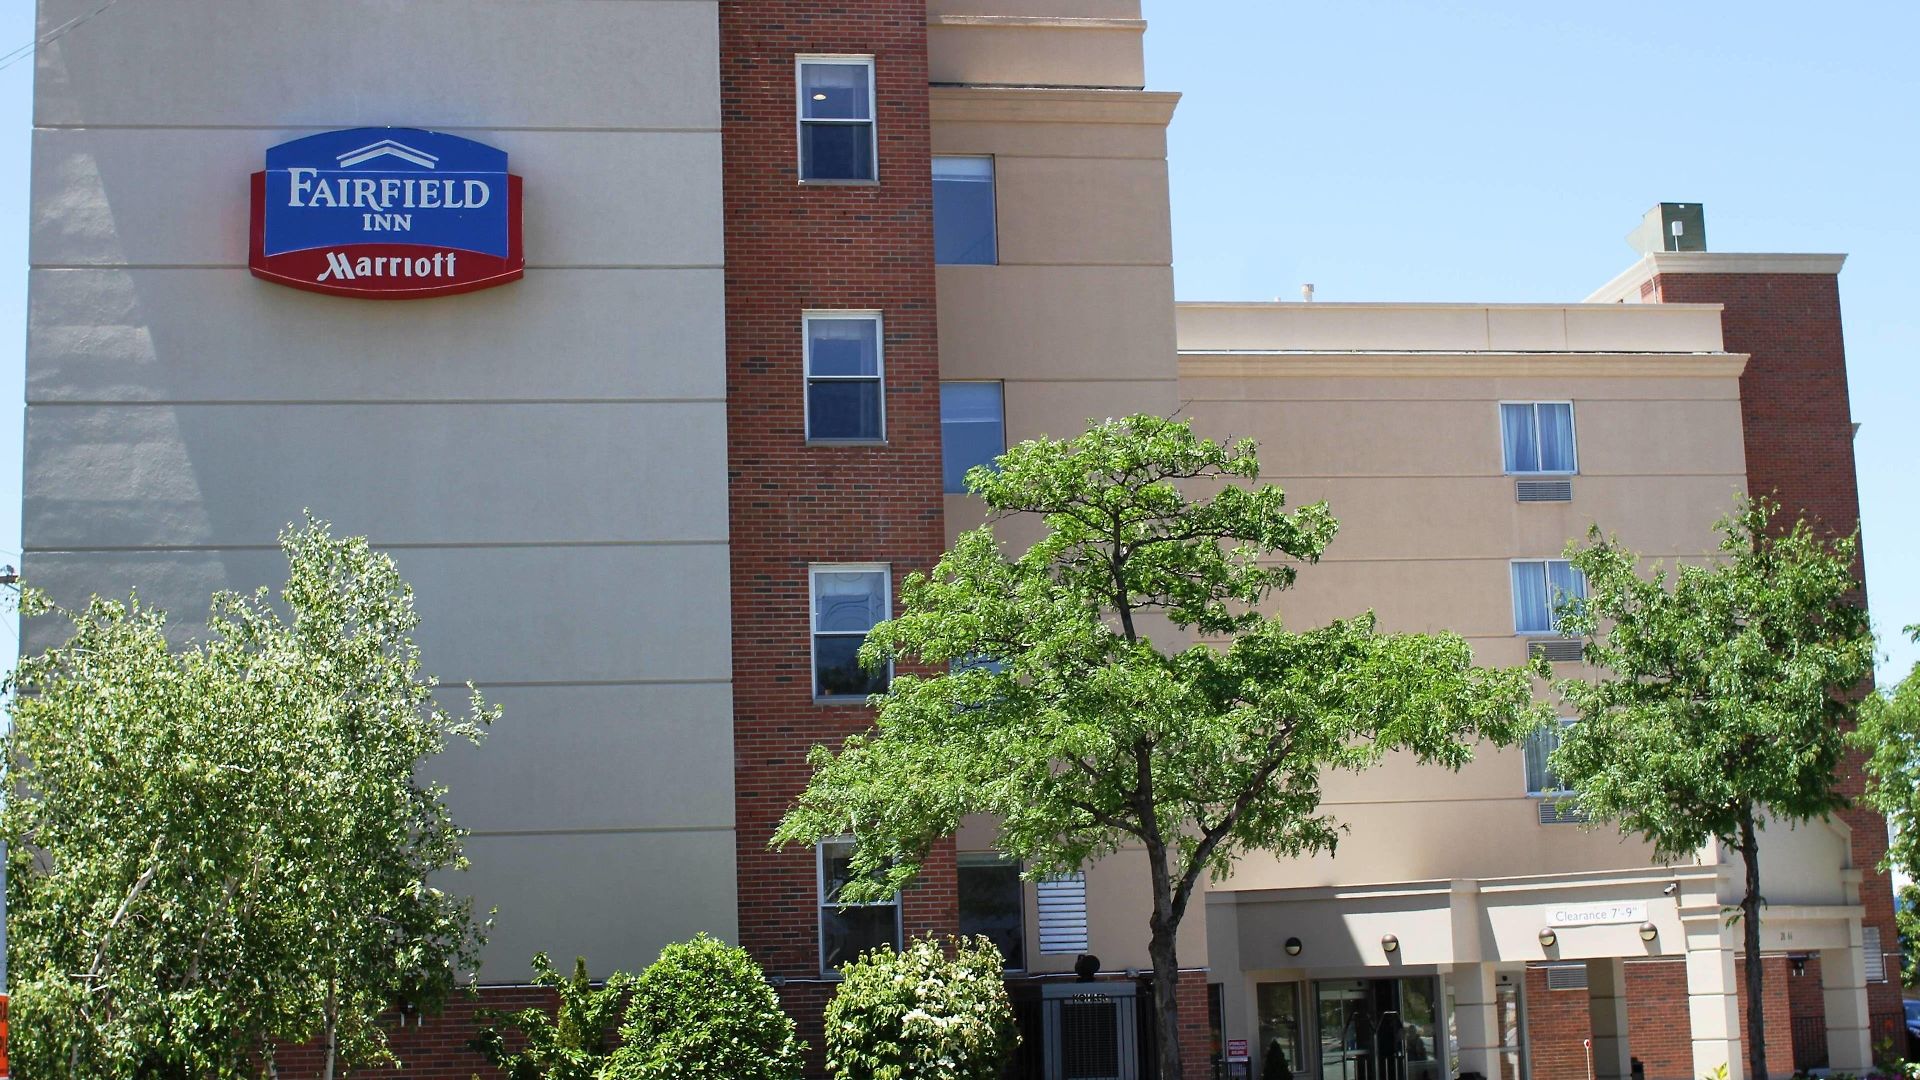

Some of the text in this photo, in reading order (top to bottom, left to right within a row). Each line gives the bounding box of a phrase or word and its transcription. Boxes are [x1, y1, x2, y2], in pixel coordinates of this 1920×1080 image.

[288, 167, 490, 212] FAIRFIELD
[363, 213, 412, 232] INN
[316, 252, 457, 282] Marriott
[1555, 911, 1607, 922] Clearance
